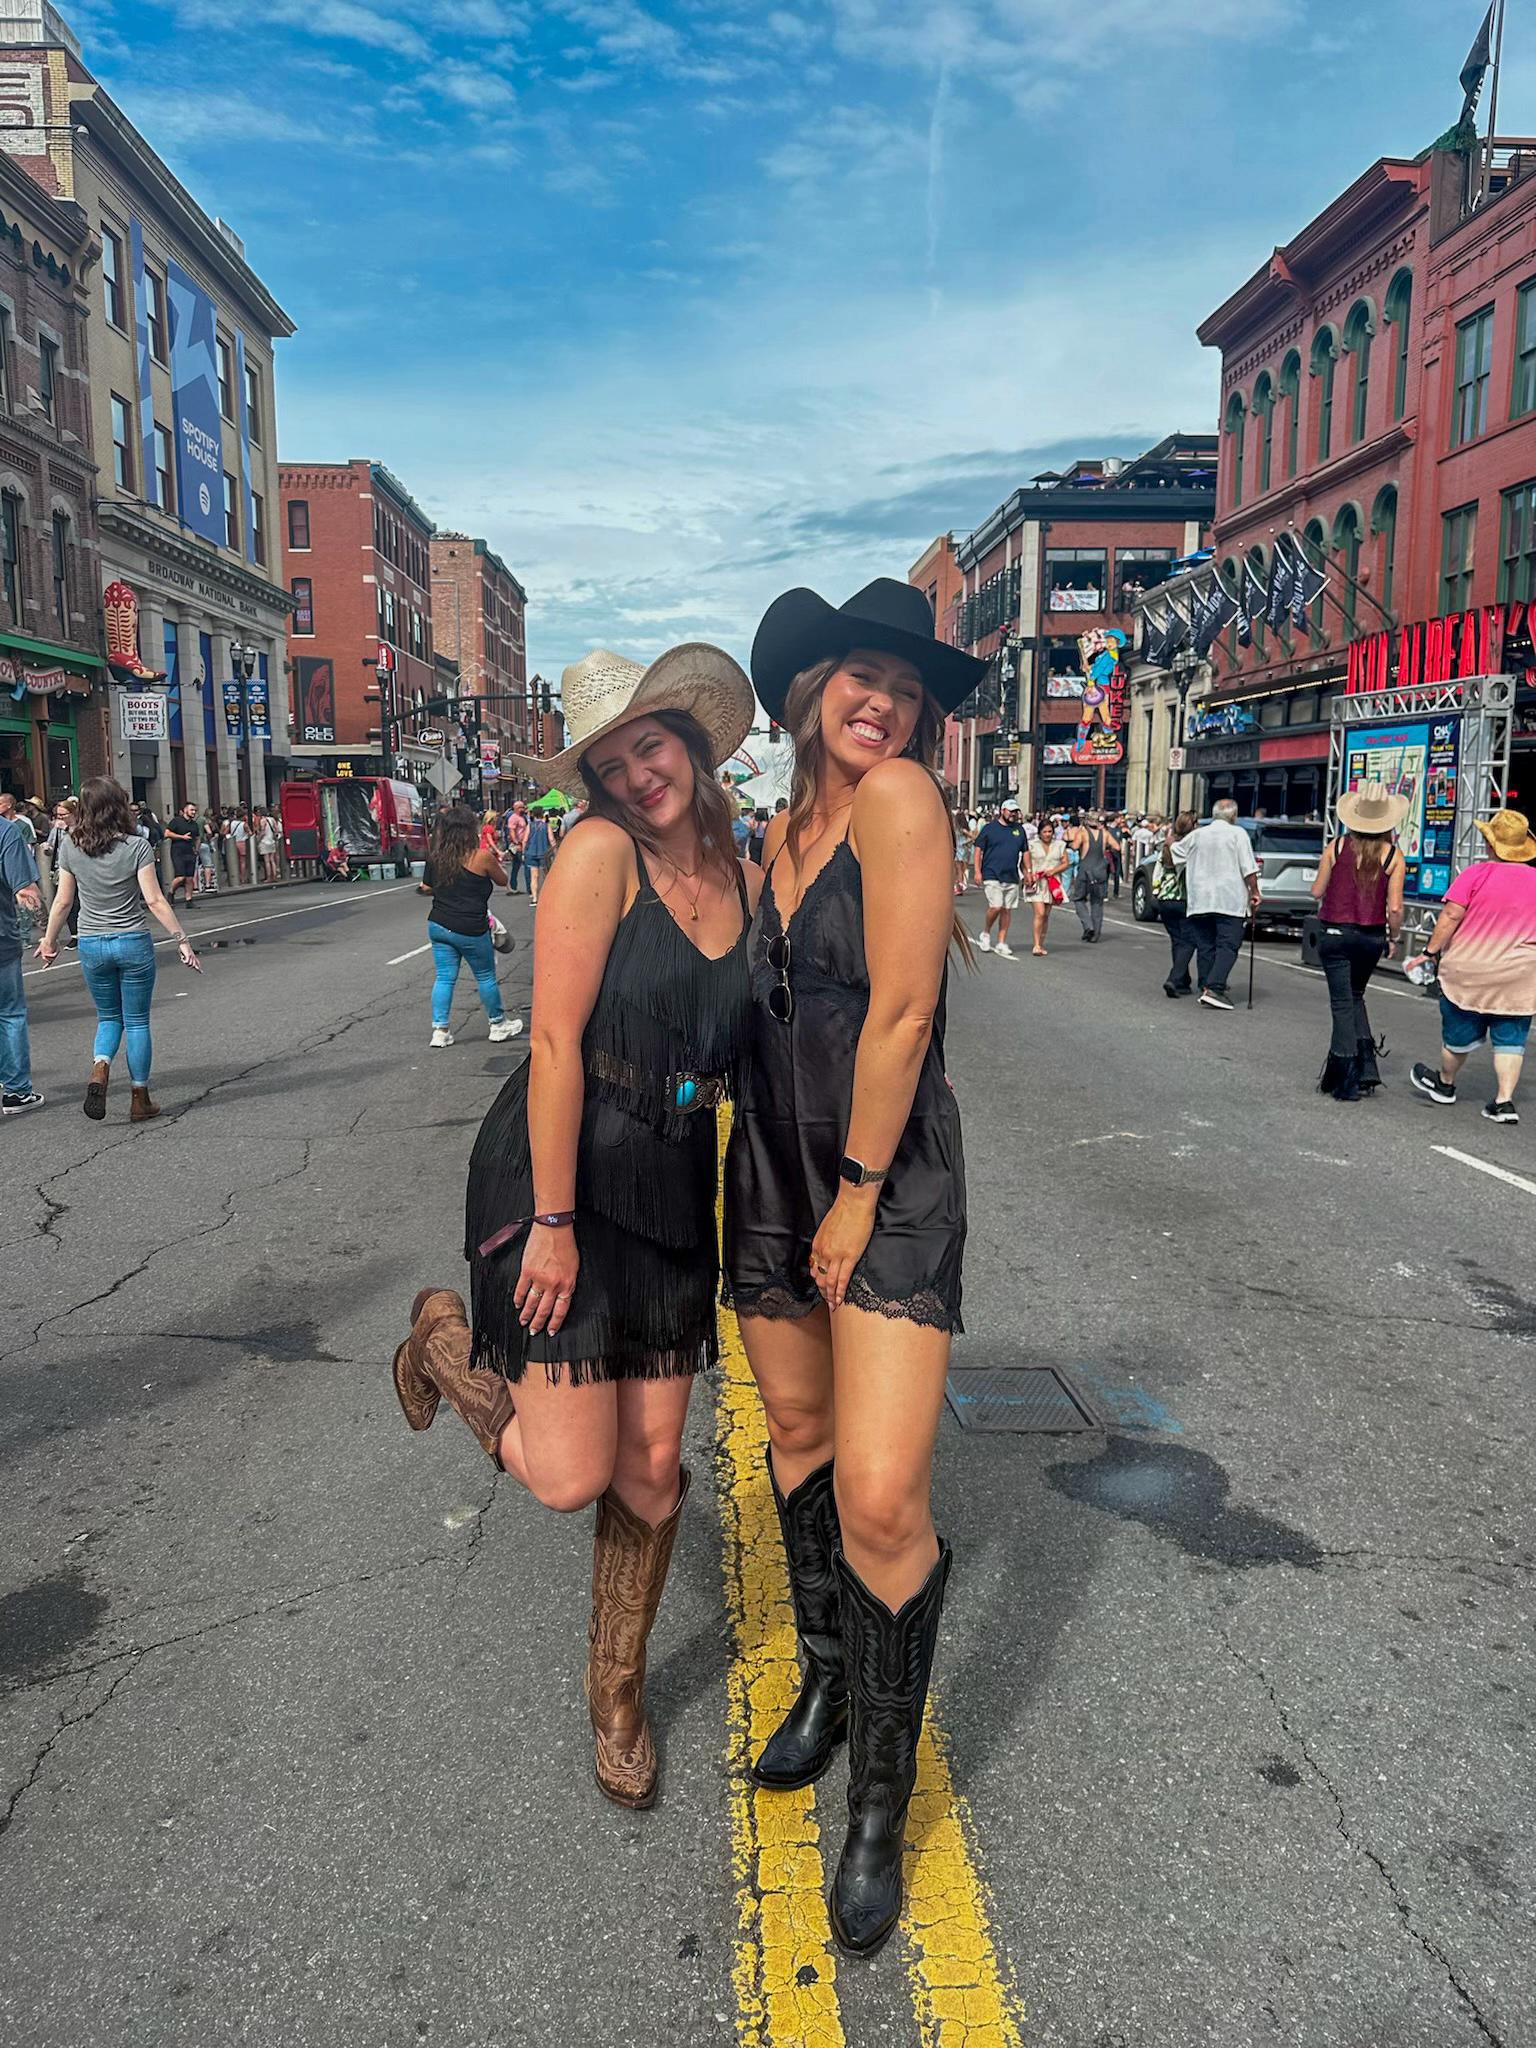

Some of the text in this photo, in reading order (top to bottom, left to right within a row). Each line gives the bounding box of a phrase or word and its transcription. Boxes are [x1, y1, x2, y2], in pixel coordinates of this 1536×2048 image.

[182, 417, 219, 456] SPOTIFY
[186, 438, 218, 472] HOUSE
[148, 560, 258, 617] BROADWAY NATIONAL BANK
[26, 671, 64, 688] COUNTRY
[128, 701, 159, 709] BOOTS
[132, 723, 157, 731] FREE
[305, 726, 333, 735] OLE
[305, 733, 334, 741] RED
[337, 762, 351, 770] ONE
[336, 770, 354, 778] LOVE
